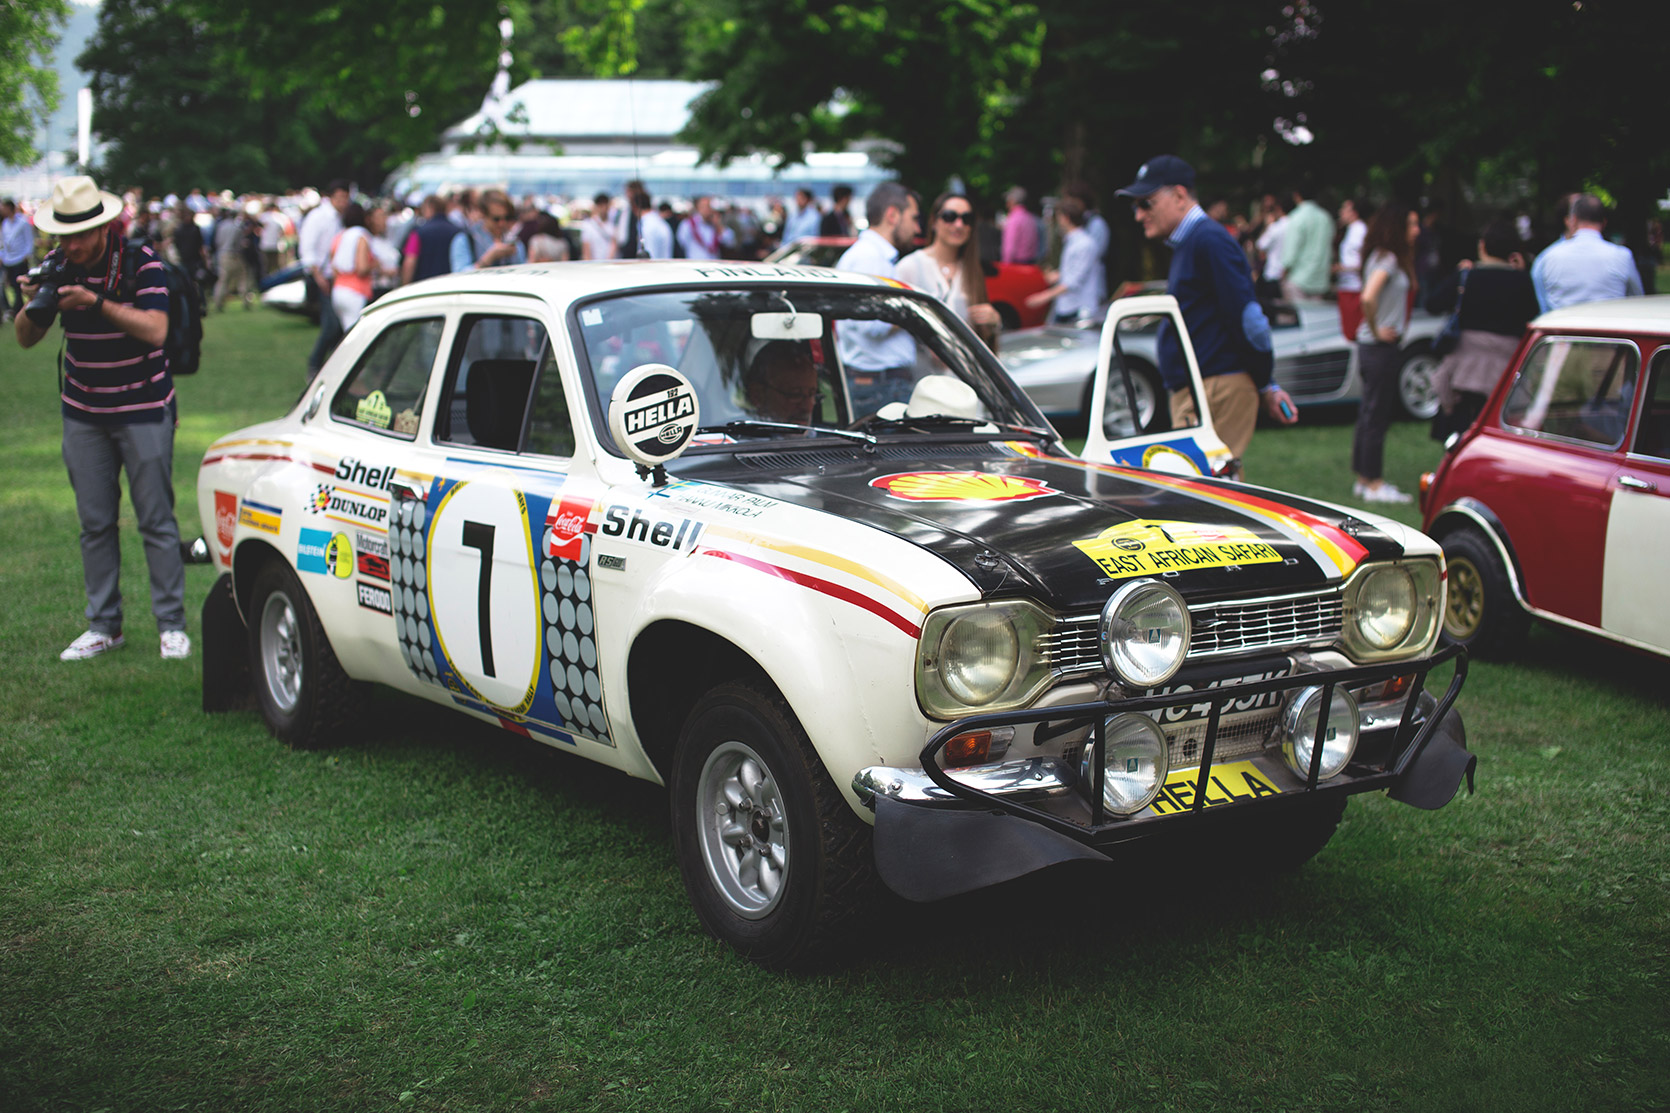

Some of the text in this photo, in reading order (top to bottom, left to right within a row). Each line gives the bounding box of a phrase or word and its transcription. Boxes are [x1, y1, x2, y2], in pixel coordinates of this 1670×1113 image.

[694, 268, 838, 278] FINLAND
[628, 396, 692, 432] HELLA
[661, 426, 682, 437] HELLA
[335, 456, 396, 491] Shell
[331, 495, 387, 522] DUNLOP
[602, 504, 703, 552] Shell
[1144, 524, 1175, 544] 7
[298, 544, 324, 557] BILSTEIN
[357, 533, 388, 555] Motorcraft
[1097, 543, 1279, 575] EAST AFRICAN SAFARI
[359, 584, 390, 611] FERODO
[462, 520, 496, 678] 7
[1151, 771, 1279, 813] HELLA
